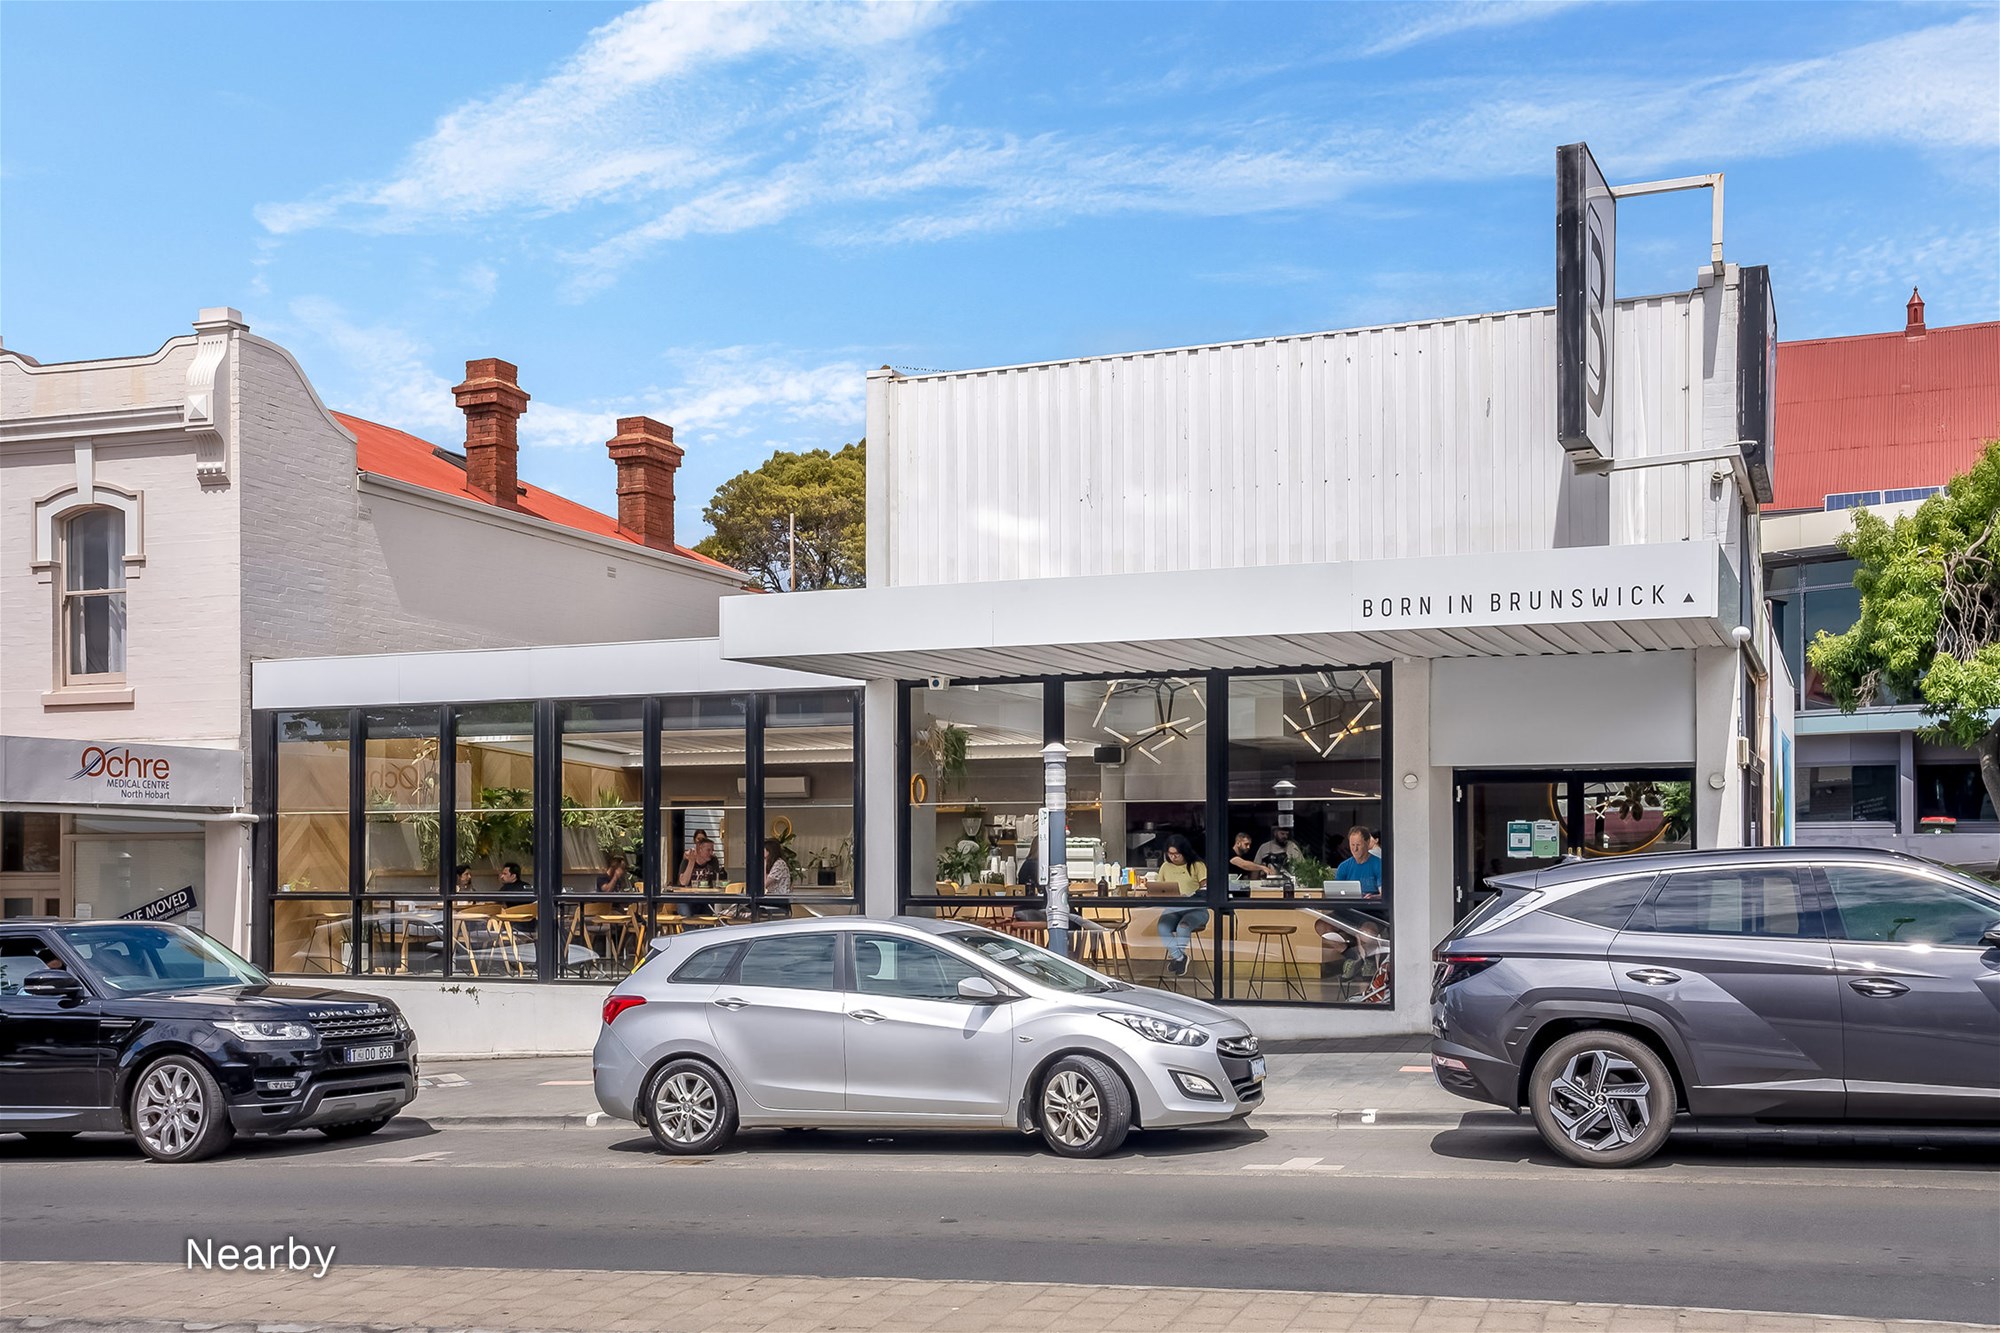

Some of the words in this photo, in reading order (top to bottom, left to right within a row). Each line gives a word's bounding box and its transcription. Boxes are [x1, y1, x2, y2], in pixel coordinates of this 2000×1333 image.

[1362, 595, 1432, 618] BORN
[1448, 594, 1473, 615] IN
[1490, 584, 1666, 612] BRUNSWICK
[81, 746, 170, 780] Ochre
[106, 779, 141, 789] MEDICAL
[142, 780, 170, 790] CENTRE
[121, 789, 143, 798] North
[144, 790, 170, 799] Hobart
[145, 891, 188, 919] MOVED
[308, 1010, 351, 1018] RANGE
[355, 1007, 388, 1015] ROVER
